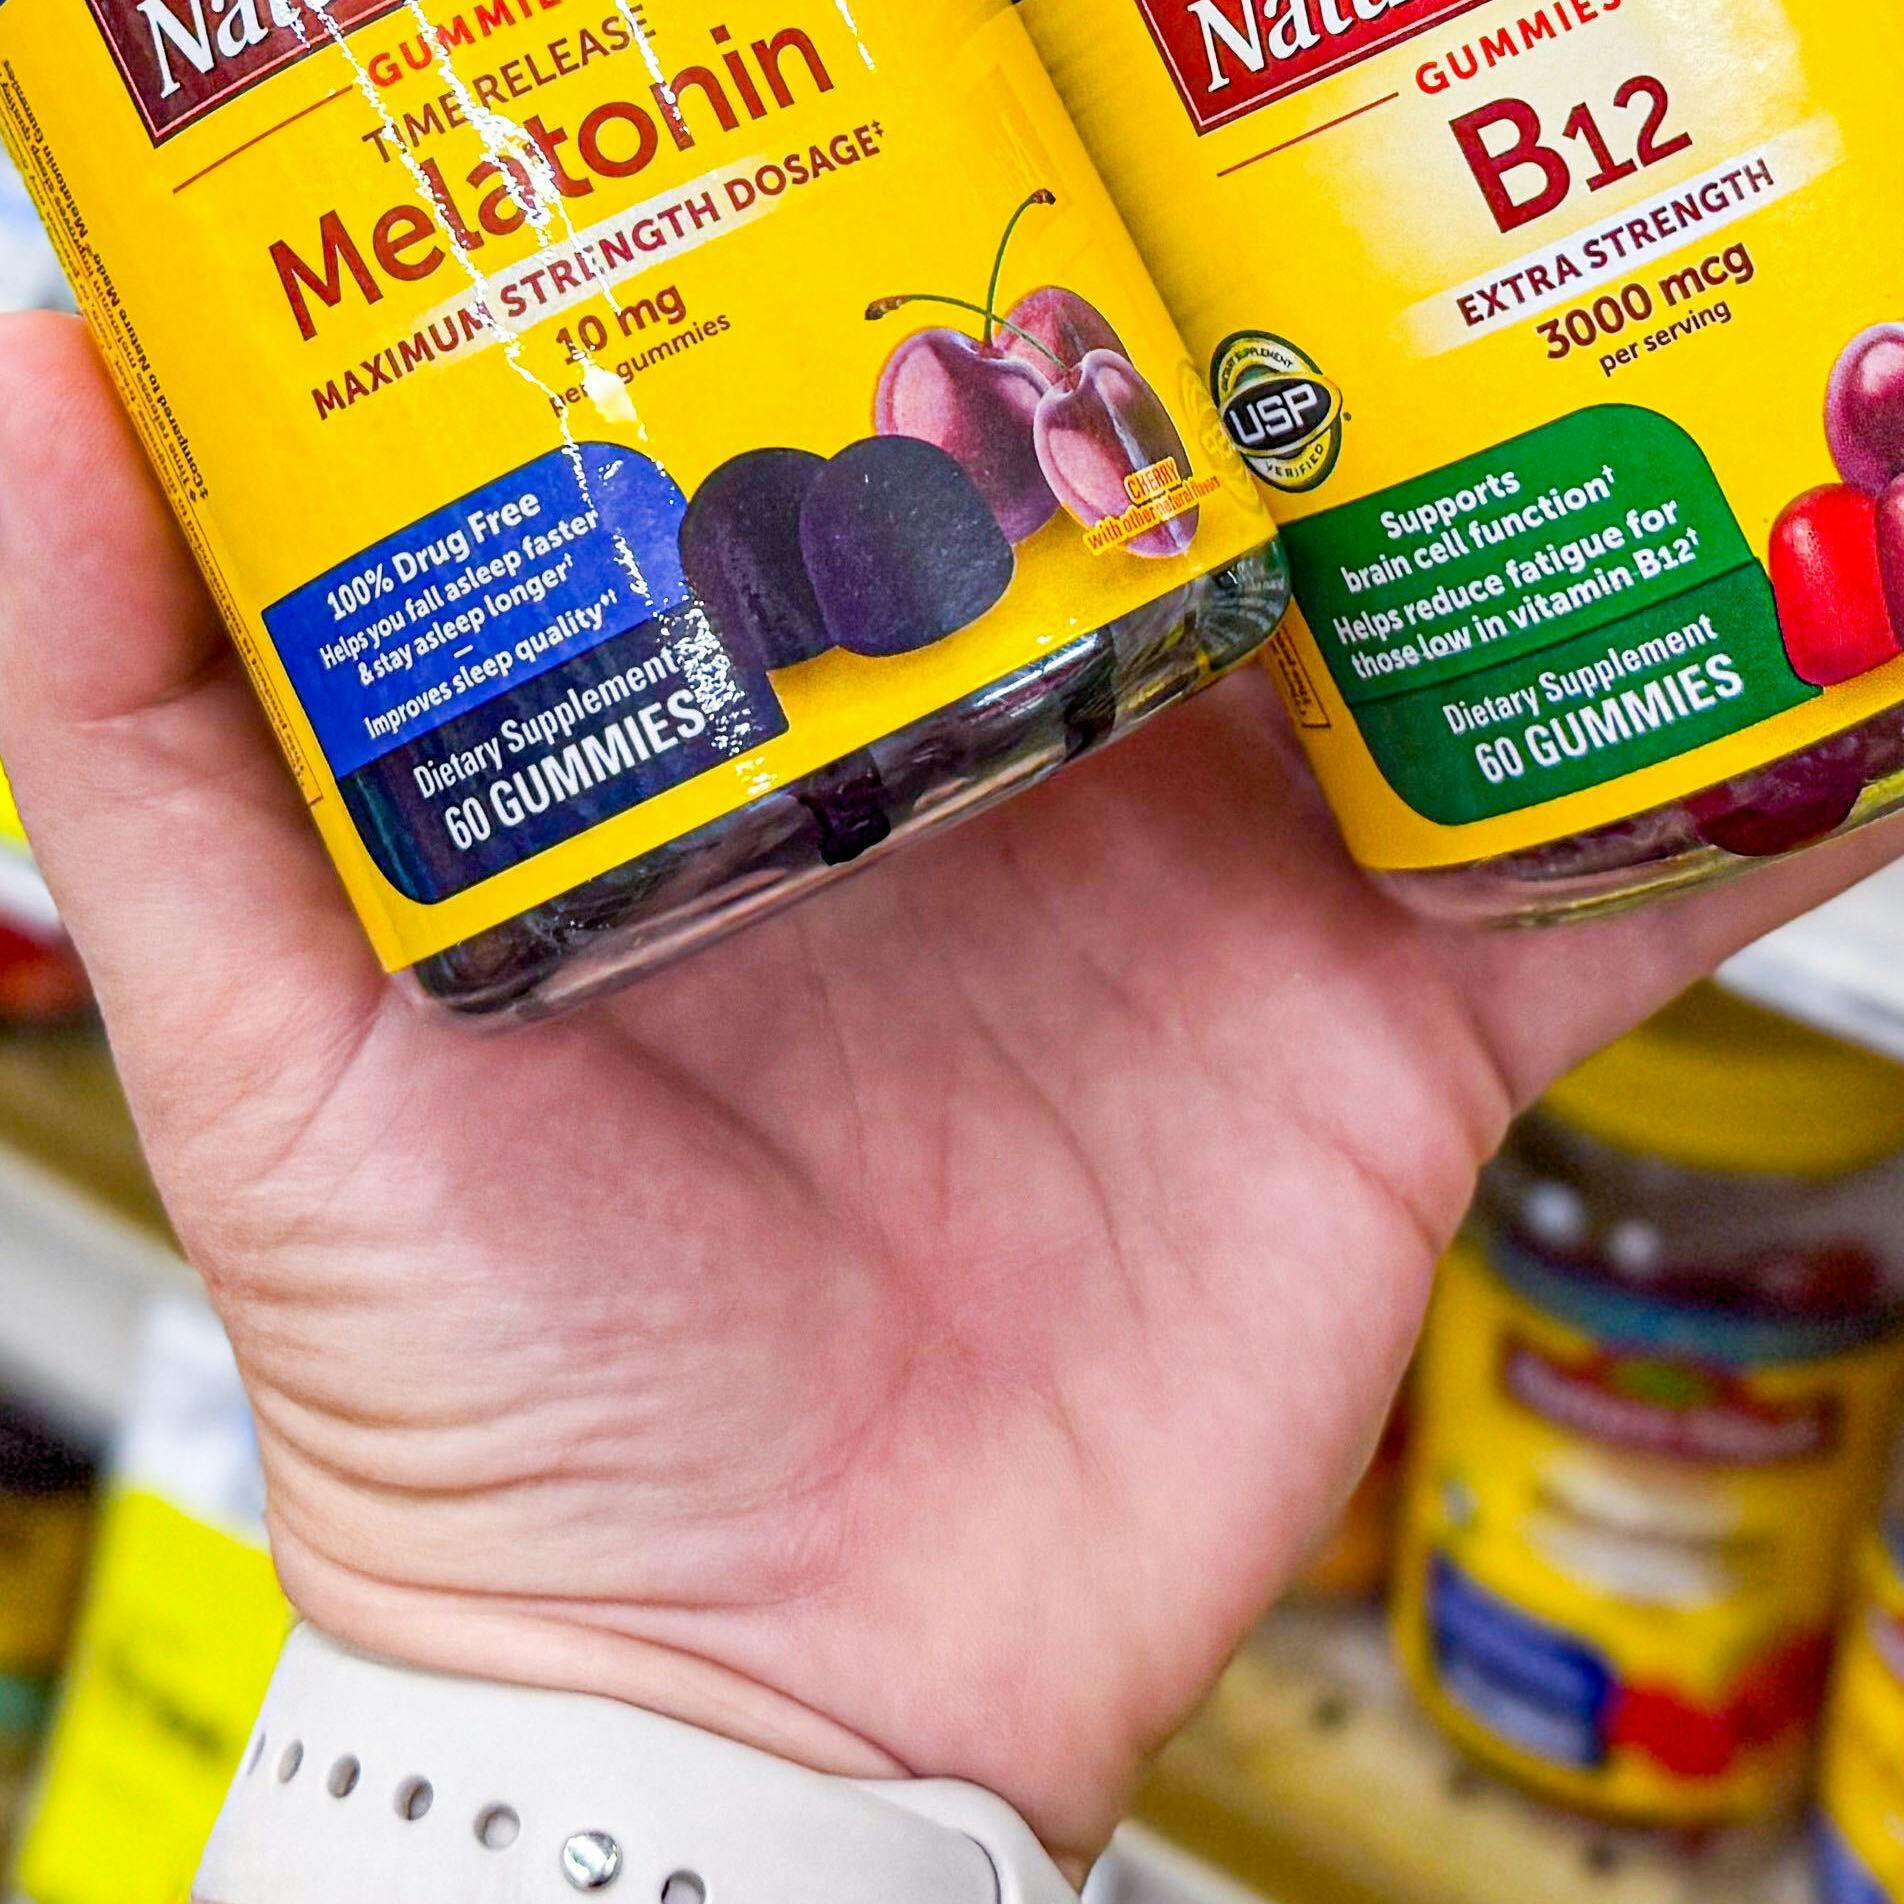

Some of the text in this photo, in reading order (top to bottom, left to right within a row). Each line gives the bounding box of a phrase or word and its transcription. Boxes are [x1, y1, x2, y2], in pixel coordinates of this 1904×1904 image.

[0, 58, 45, 144] Gummies
[360, 3, 657, 165] TIME RELEASE
[39, 144, 89, 238] Melatonin
[267, 22, 836, 343] Melatonin
[1447, 74, 1694, 235] B12
[1455, 157, 1775, 328] EXTRA STRENGTH
[90, 279, 137, 369] melatonin
[114, 308, 151, 372] Nature
[310, 298, 496, 421] MAXIMUM
[499, 196, 723, 318] STRENGTH
[554, 283, 689, 366] 10 mg
[1535, 241, 1756, 361] 3000 mcg
[1598, 300, 1733, 378] per serving
[132, 371, 170, 439] release
[548, 308, 732, 419] per gummies
[1229, 382, 1318, 444] USP
[1126, 462, 1179, 500] CHERRY
[1265, 442, 1325, 478] VERIFIED
[1379, 470, 1522, 541] Supports
[326, 492, 542, 623] 100% Drug Free
[1087, 520, 1124, 549] with
[1122, 506, 1156, 533] other
[1332, 499, 1680, 647] Helps reduce fatigue for
[1340, 552, 1413, 595] brain
[1413, 526, 1470, 572] cell
[318, 508, 600, 670] Helps you fall asleep faster
[1351, 638, 1421, 681] those
[1417, 627, 1474, 662] low
[1471, 613, 1507, 644] in
[1506, 567, 1635, 631] vitamin
[357, 660, 375, 688] &
[370, 642, 415, 679] stay
[412, 603, 487, 658] asleep
[362, 649, 515, 741] Improves sleep
[1442, 612, 1720, 736] Dietary Supplement
[412, 644, 682, 800] Dietary Supplement
[444, 687, 708, 851] 60 GUMMIES
[1474, 652, 1746, 786] 60 GUMMIES
